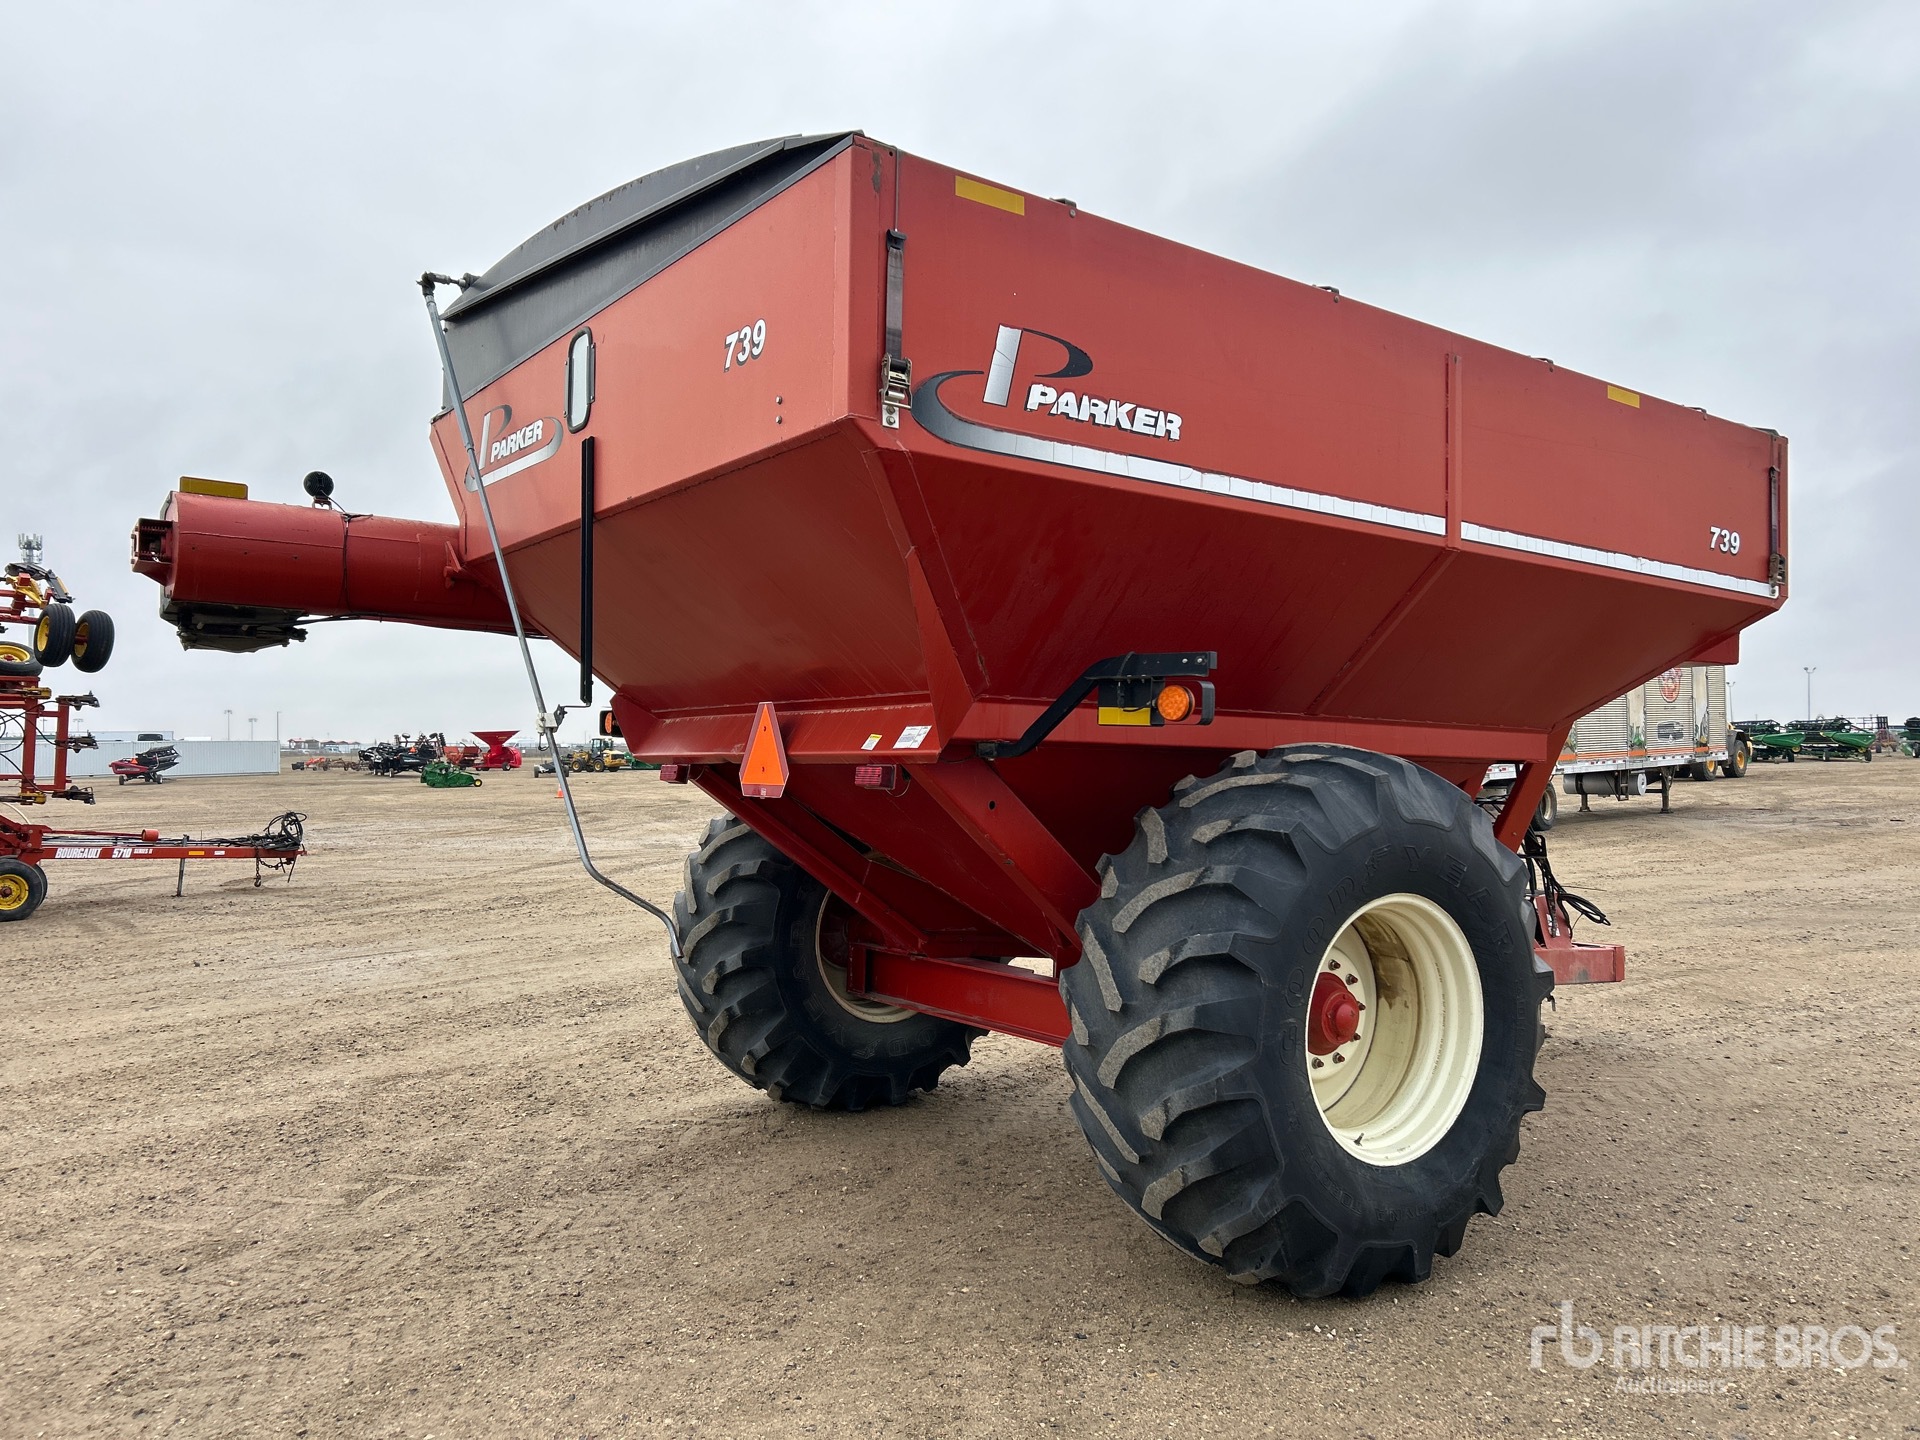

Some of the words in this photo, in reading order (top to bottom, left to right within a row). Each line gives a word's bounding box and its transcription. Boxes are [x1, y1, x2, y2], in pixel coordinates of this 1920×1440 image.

[724, 318, 767, 373] 739
[1026, 383, 1183, 442] PARKER
[490, 418, 544, 464] PARKER
[1709, 525, 1741, 556] 739
[56, 848, 102, 858] BOURGAULT
[111, 848, 132, 858] 5710
